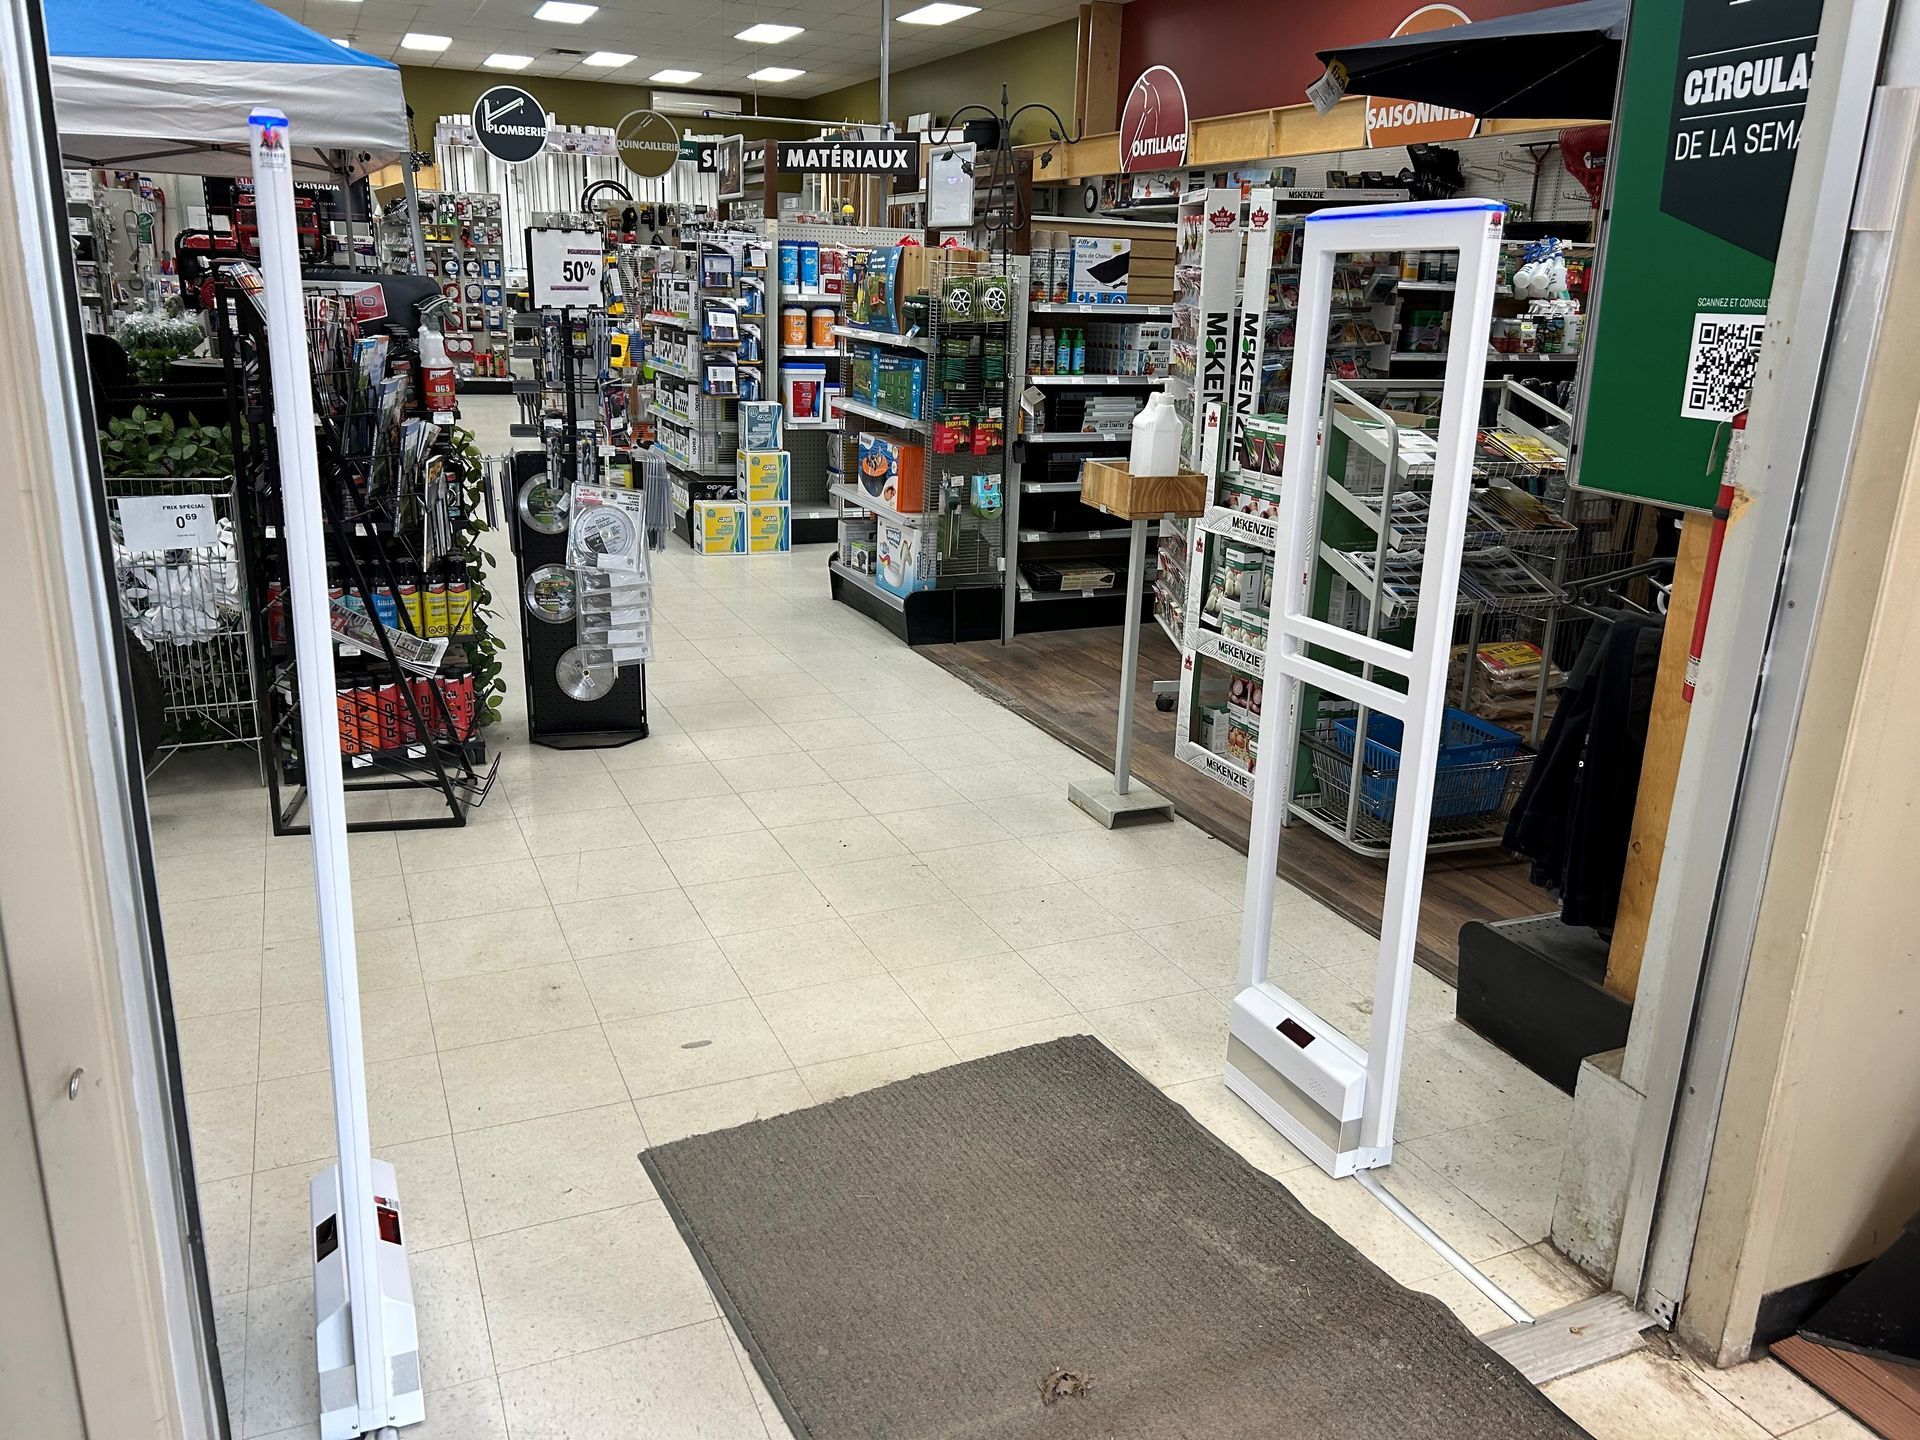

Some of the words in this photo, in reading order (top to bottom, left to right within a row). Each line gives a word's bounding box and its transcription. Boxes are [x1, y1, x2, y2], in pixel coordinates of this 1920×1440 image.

[487, 124, 547, 137] PLOMBERIE
[616, 139, 679, 152] QUINCAILLERIE
[786, 143, 908, 168] MATÉRIAUX
[1132, 133, 1187, 157] OUTILLAGE
[1674, 130, 1705, 162] DE
[1708, 126, 1737, 157] LA
[562, 260, 596, 283] 50%
[1697, 296, 1729, 307] SCANNEZ
[1729, 298, 1739, 307] ET
